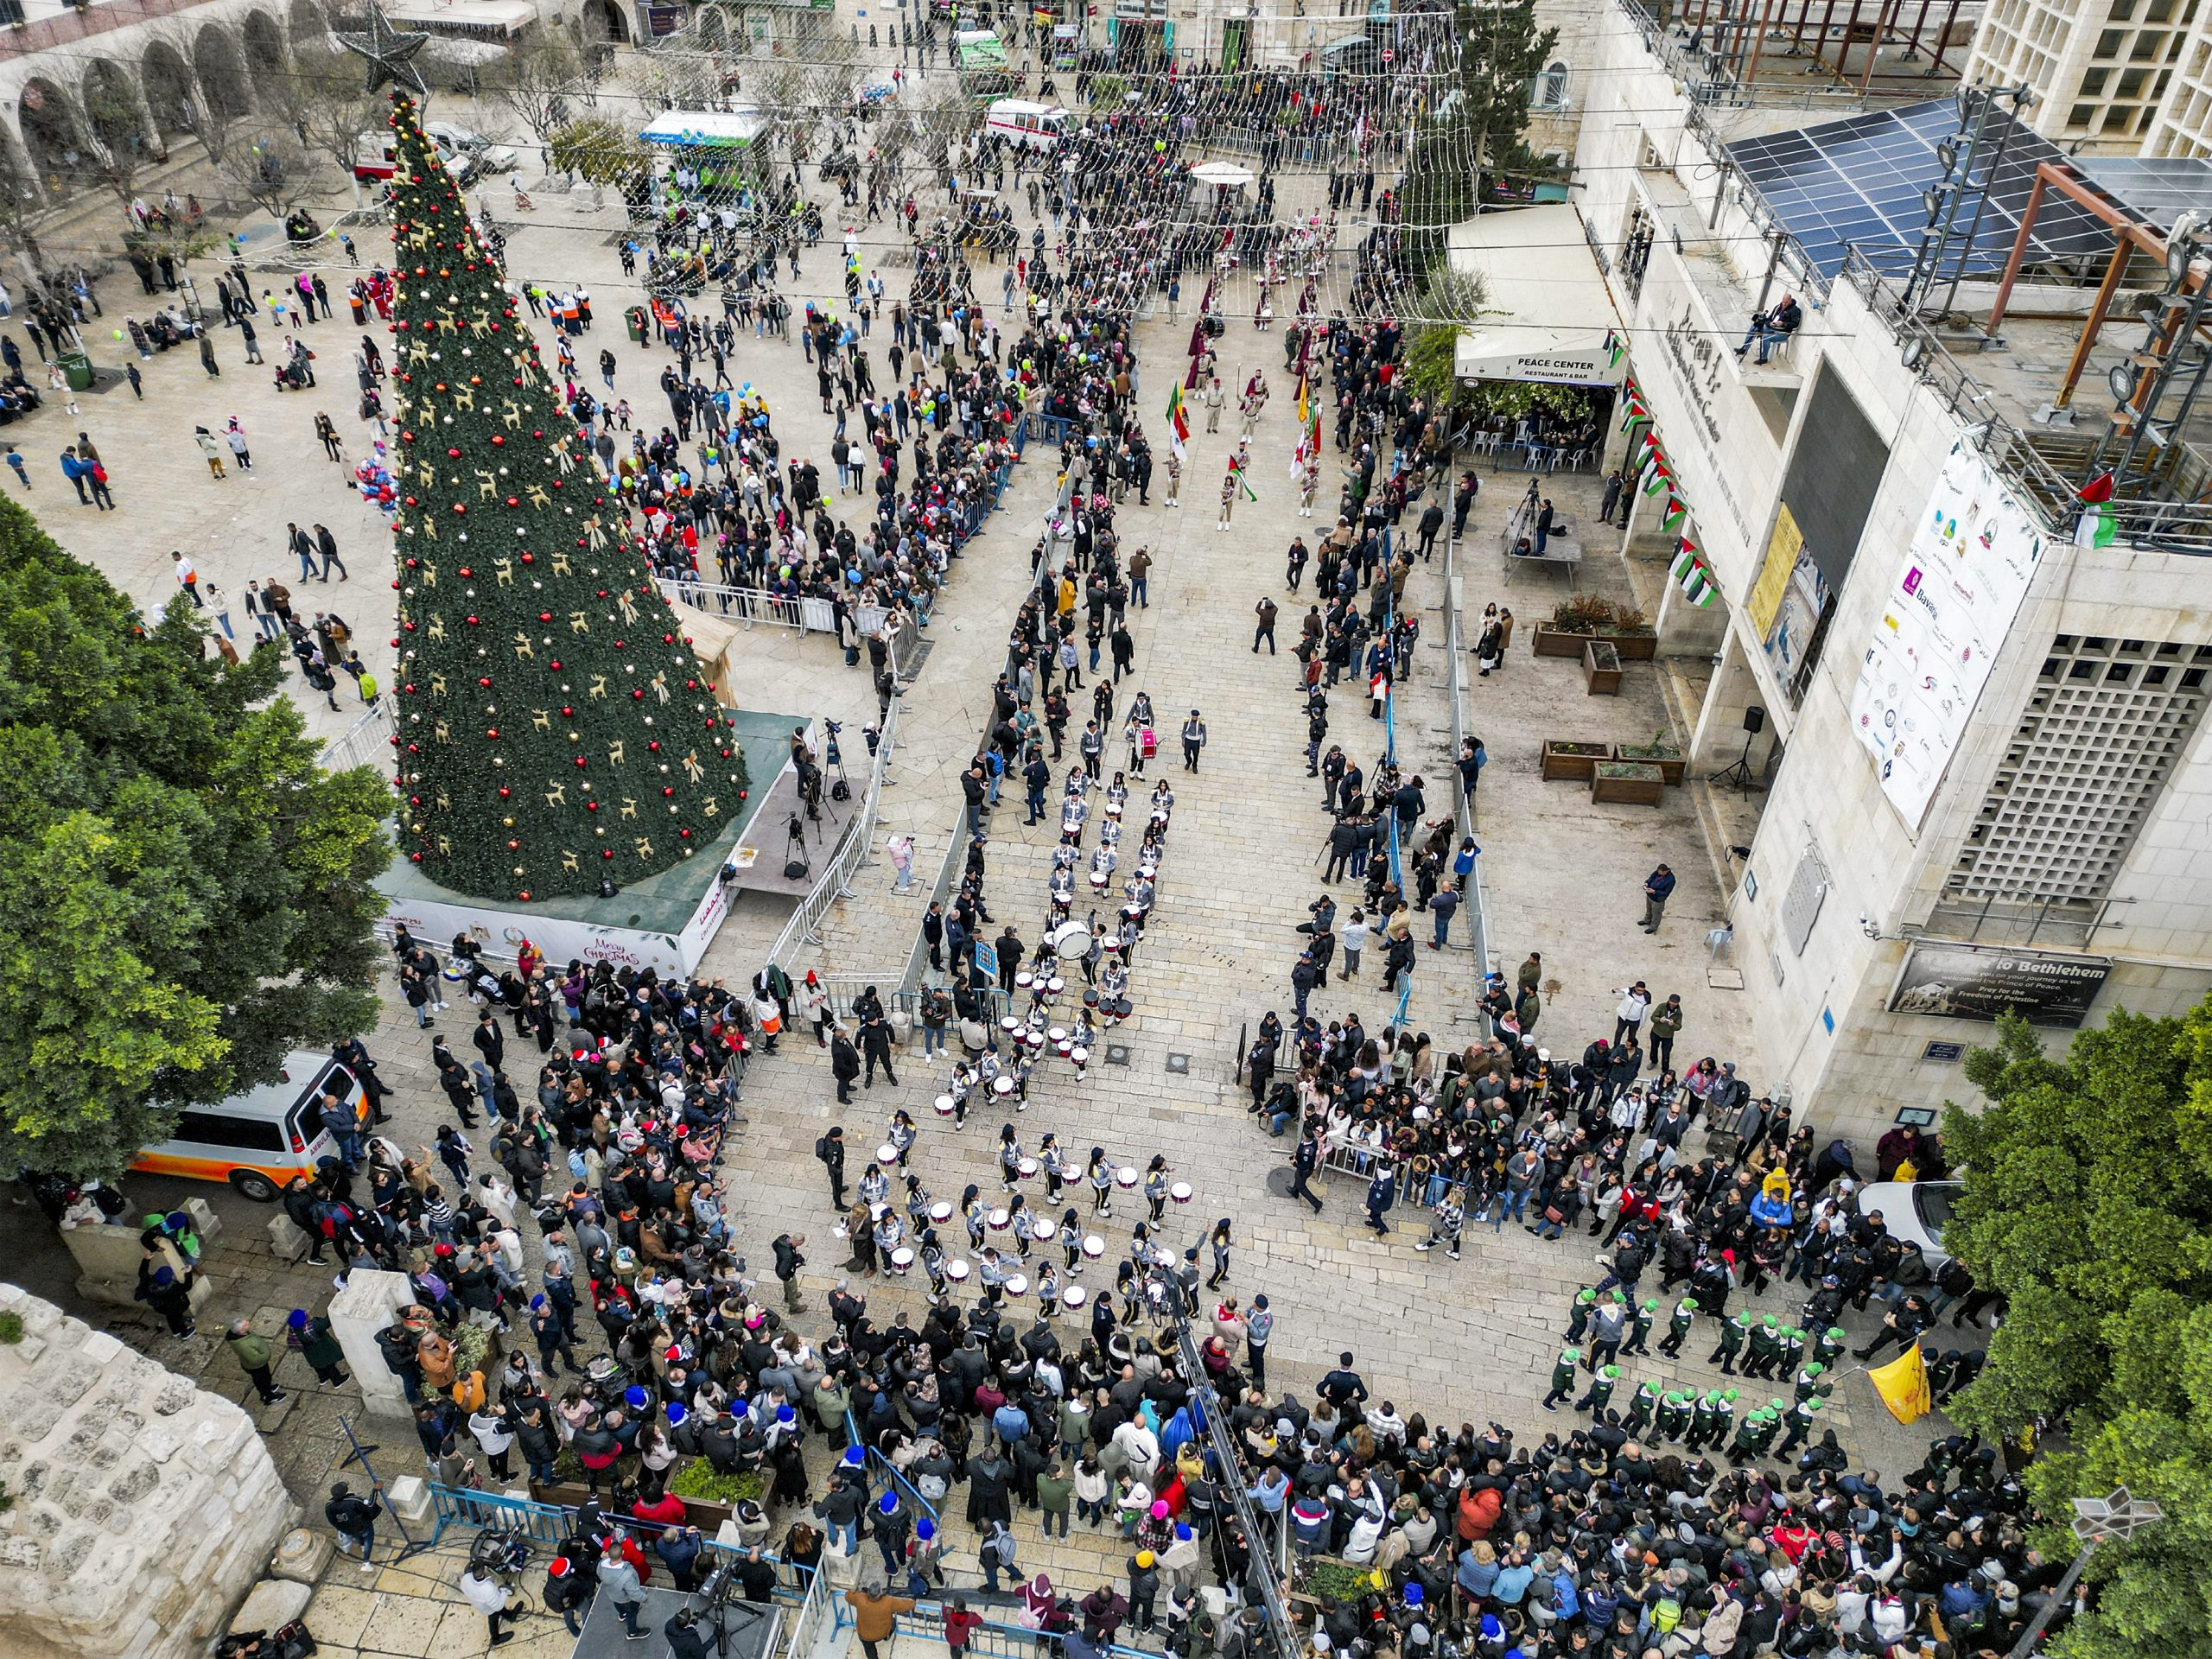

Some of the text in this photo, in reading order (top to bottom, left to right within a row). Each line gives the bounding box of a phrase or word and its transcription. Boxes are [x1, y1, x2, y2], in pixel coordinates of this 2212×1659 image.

[1518, 358, 1594, 370] PEACE CENTER
[1524, 370, 1567, 378] RESTAURANT
[594, 938, 626, 952] Merry
[583, 946, 639, 965] CHRISTMAS
[1996, 957, 2012, 969] to
[2018, 961, 2106, 979] Bethlehem
[1942, 975, 1982, 983] welcomed
[2025, 975, 2057, 983] journey
[2004, 995, 2039, 1003] Palestine
[310, 1129, 332, 1156] AMBULA
